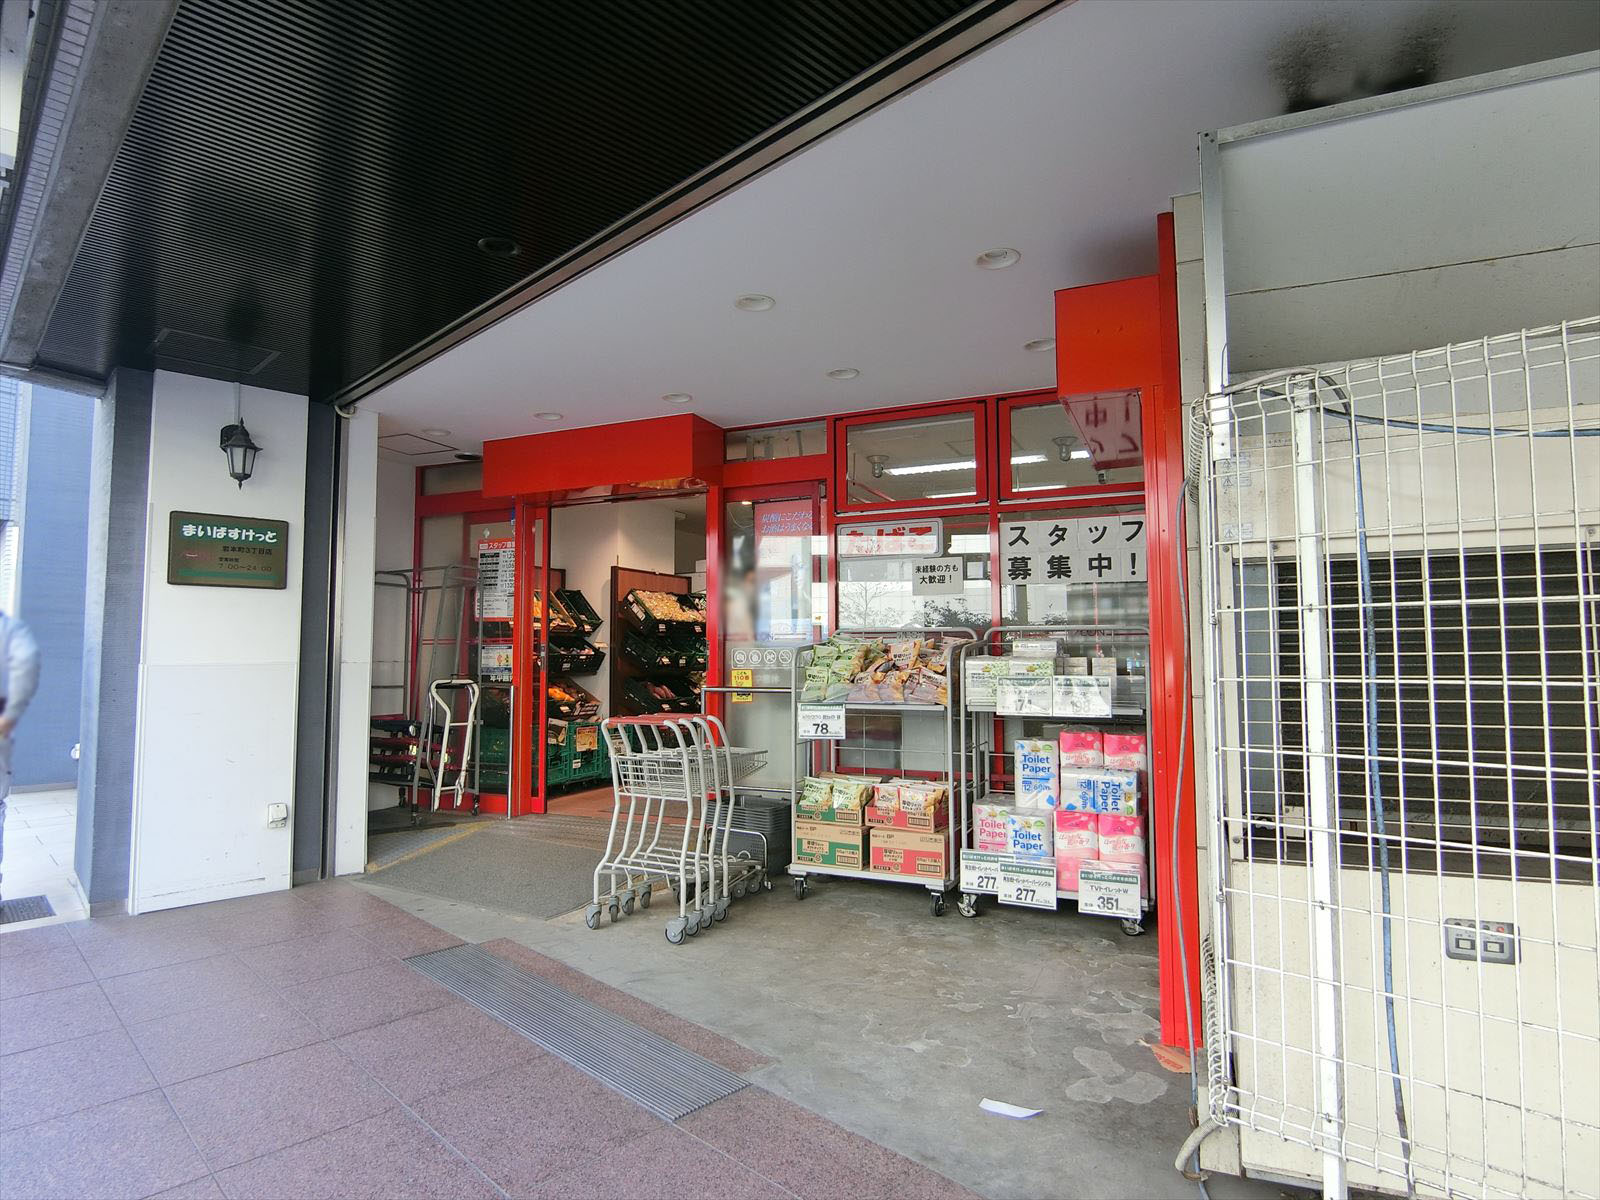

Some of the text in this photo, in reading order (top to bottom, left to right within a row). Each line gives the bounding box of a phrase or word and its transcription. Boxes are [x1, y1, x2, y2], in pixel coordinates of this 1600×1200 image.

[182, 524, 277, 543] まいばすけっと
[1008, 520, 1144, 547] スタッフ
[915, 564, 958, 573] 未経験の方も
[812, 723, 829, 734] 78
[1022, 755, 1050, 764] Toilet
[1022, 764, 1052, 774] Paper
[1099, 781, 1111, 811] Paper
[1111, 782, 1120, 811] Toilet
[980, 819, 1006, 829] Toilet
[1013, 830, 1042, 841] Toilet
[1013, 840, 1044, 851] Paper
[977, 875, 997, 890] 277
[1016, 888, 1036, 902] 277
[1097, 896, 1119, 911] 351
